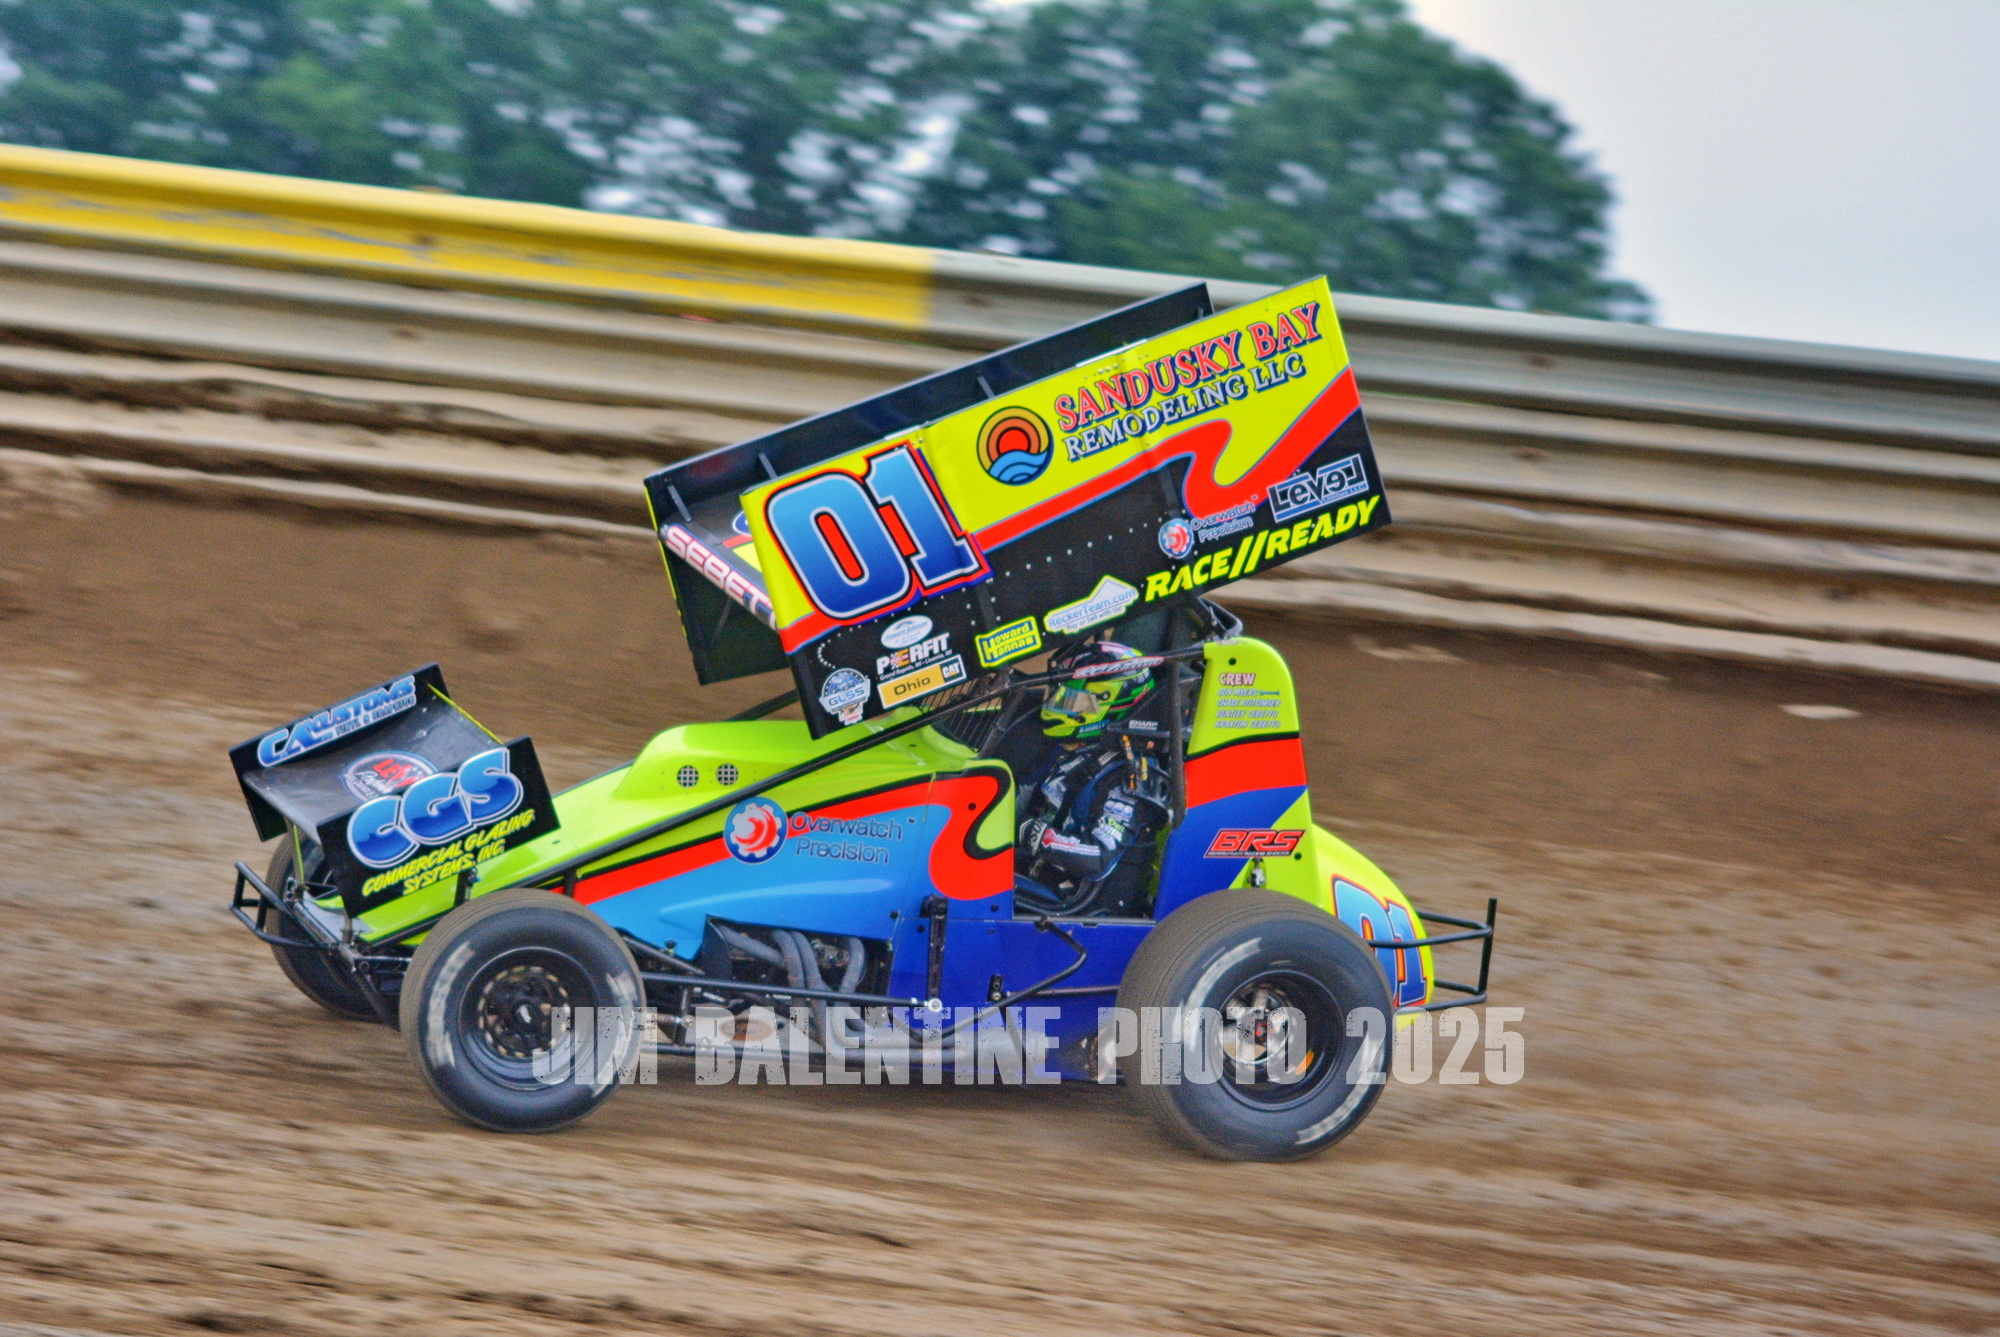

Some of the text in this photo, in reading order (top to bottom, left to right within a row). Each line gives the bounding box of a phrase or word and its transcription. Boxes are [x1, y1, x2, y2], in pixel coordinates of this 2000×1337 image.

[1054, 302, 1322, 432] SANDUSKY BAY
[1063, 352, 1307, 463] REMODELING LLC
[1190, 501, 1256, 531] Overwatch
[1198, 516, 1253, 543] Precision
[765, 442, 990, 624] 01
[1048, 588, 1136, 628] ReckerTeam.com
[893, 662, 960, 696] Ohio CAT
[1219, 673, 1256, 687] CREW
[828, 687, 865, 706] GLSS
[347, 746, 524, 869] CGS
[790, 811, 902, 841] Overwatch
[1208, 830, 1304, 852] BRS
[362, 808, 536, 897] COMMERCIAL GLAZING
[795, 836, 890, 865] Precision
